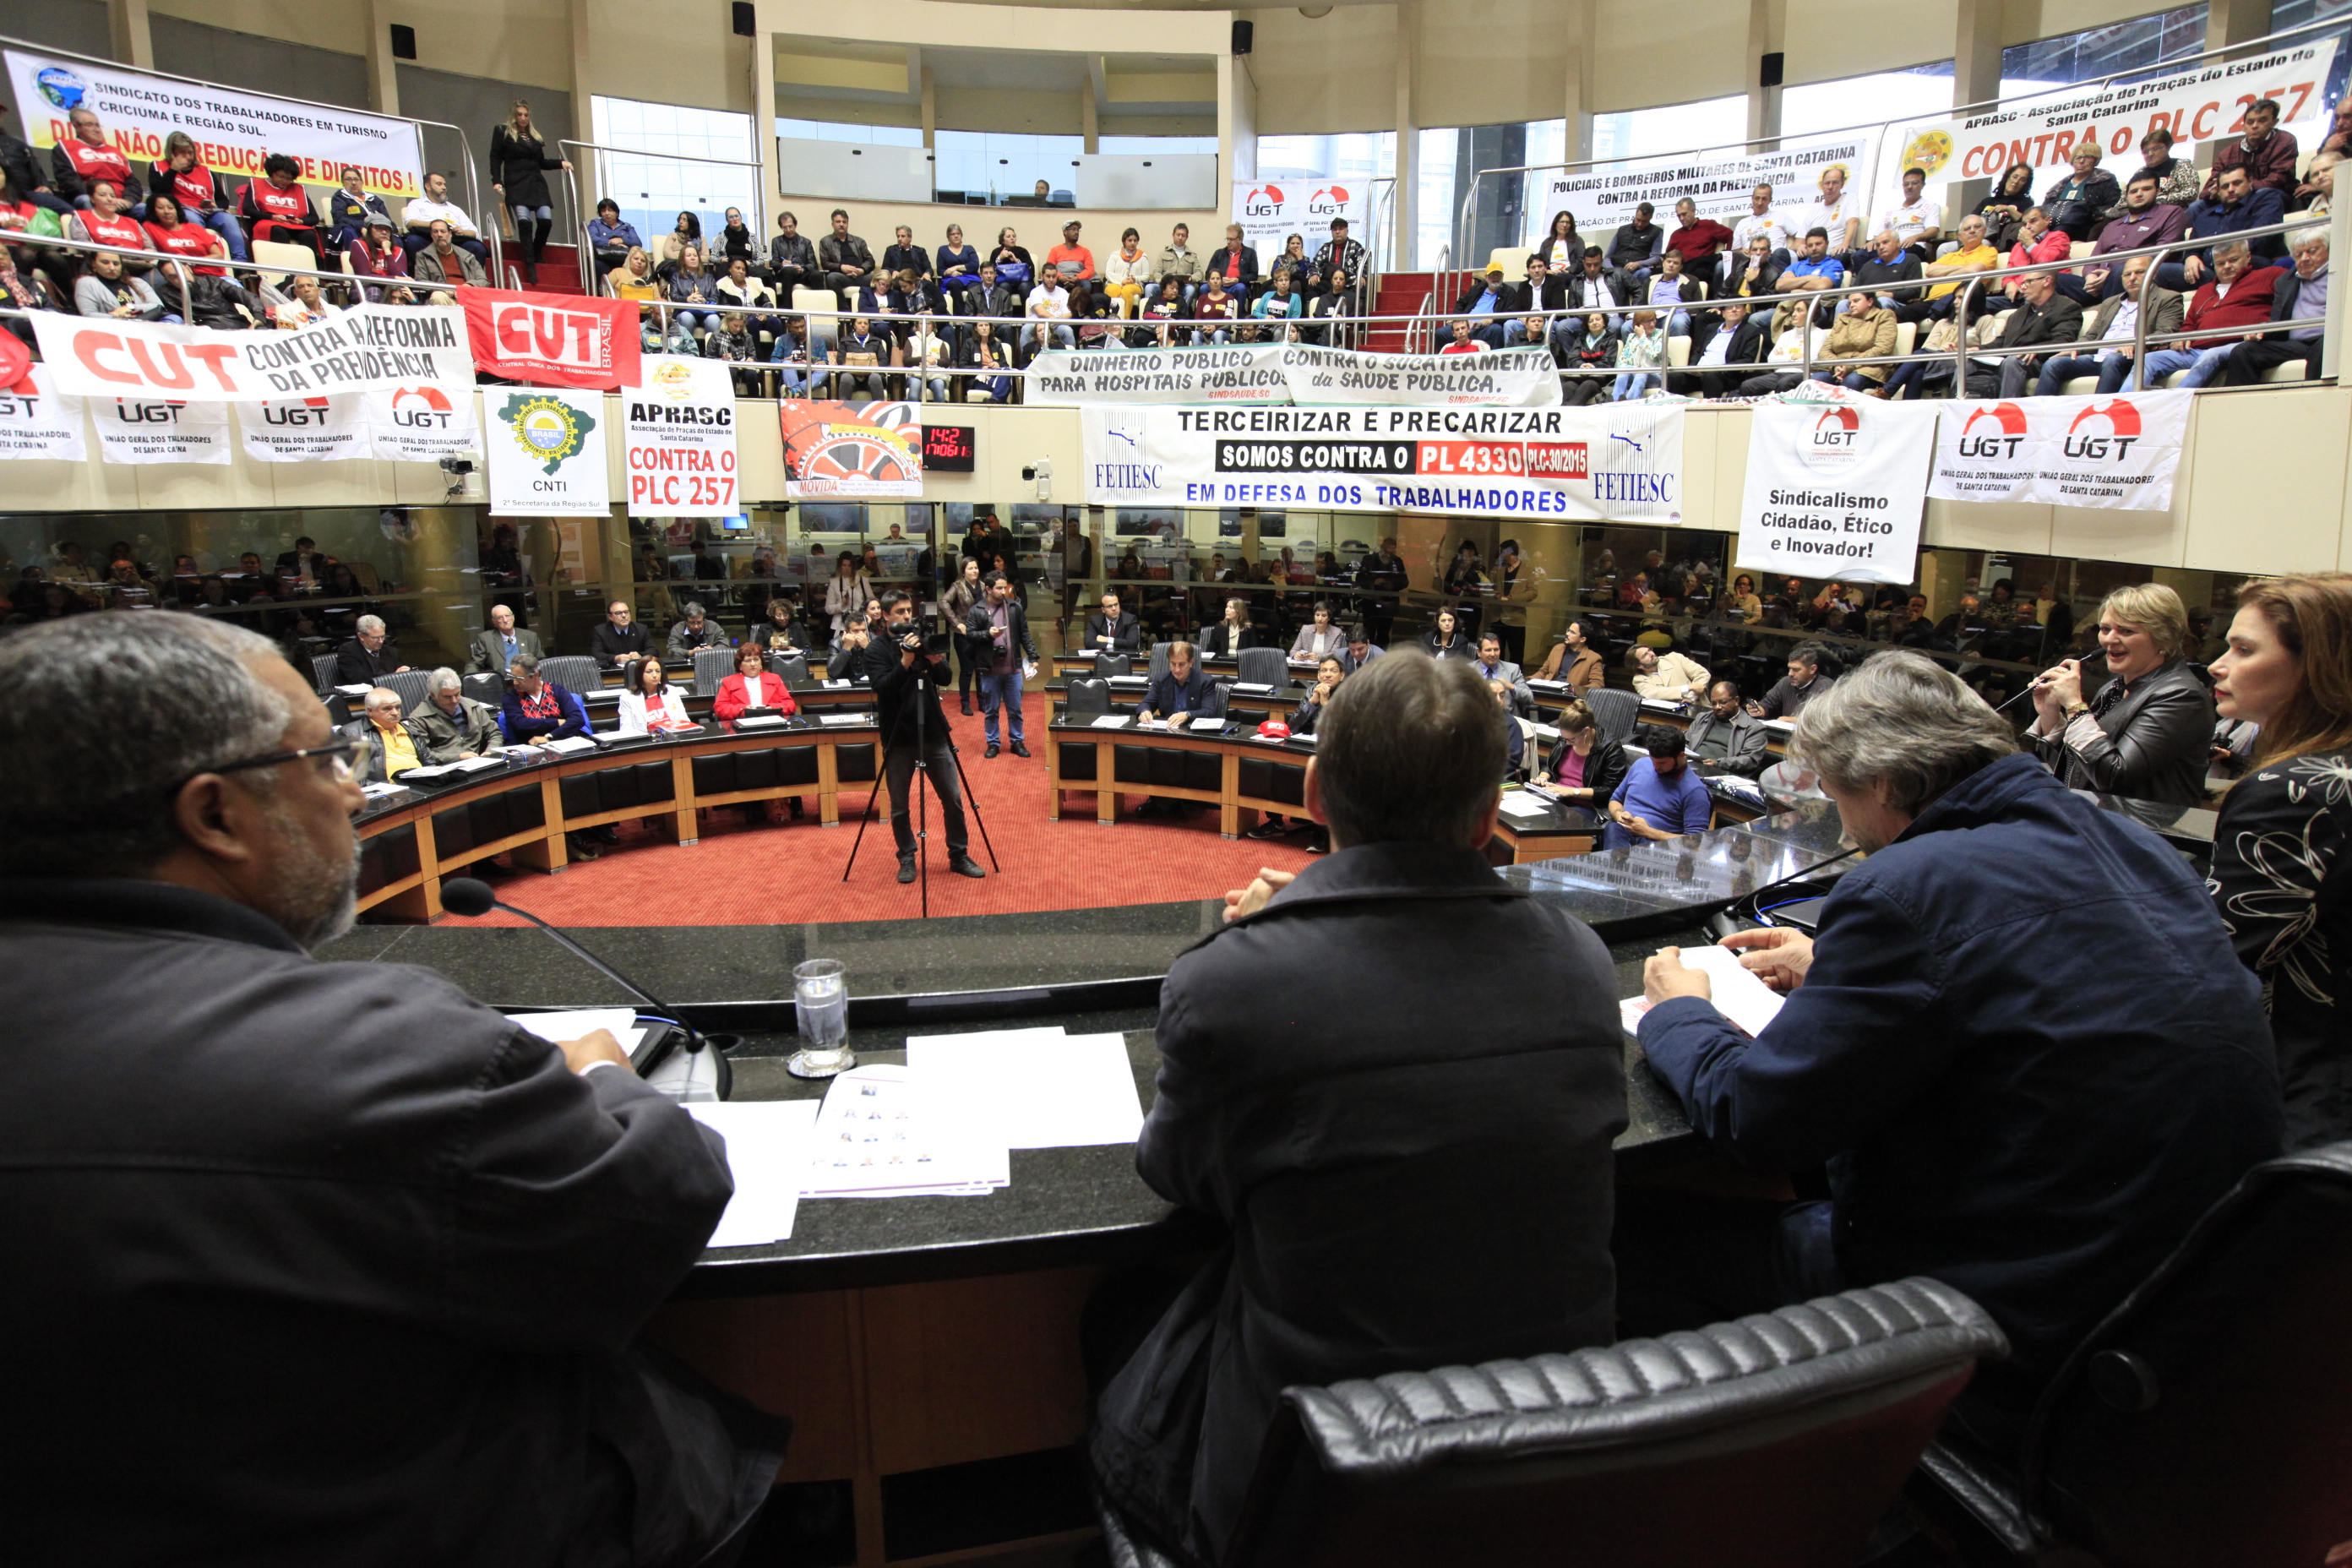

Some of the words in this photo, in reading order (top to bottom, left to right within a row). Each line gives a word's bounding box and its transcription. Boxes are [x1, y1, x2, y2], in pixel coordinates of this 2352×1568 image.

[1964, 112, 2017, 130] APRASC
[2028, 92, 2112, 118] Associação
[2117, 88, 2137, 100] de
[2140, 75, 2197, 96] Praças
[2201, 68, 2223, 83] do
[2226, 56, 2288, 78] Estado
[2291, 49, 2316, 62] de
[95, 82, 171, 105] SINDICATO
[174, 96, 202, 110] DOS
[205, 101, 313, 128] TRABALHADORES
[317, 120, 334, 132] EM
[336, 123, 388, 139] TURISMO
[100, 101, 169, 122] CRICIÚMA
[173, 113, 182, 123] E
[186, 115, 234, 132] REGIÃO
[238, 123, 267, 137] SUL.
[2046, 112, 2088, 128] Santa
[2091, 97, 2159, 119] Catarina
[78, 148, 119, 161] CUT
[115, 127, 162, 158] NÃO
[296, 155, 317, 179] DE
[1553, 178, 1603, 193] POLICIAIS
[1605, 177, 1611, 188] E
[1613, 171, 1674, 188] BOMBEIROS
[1676, 163, 1735, 181] MILITARES
[1738, 161, 1752, 172] DE
[1755, 155, 1793, 171] SANTA
[1795, 145, 1855, 166] CATARINA
[265, 194, 296, 206] CUT
[1597, 191, 1639, 206] CONTRA
[1641, 189, 1647, 202] A
[1650, 183, 1700, 201] REFORMA
[1703, 182, 1718, 195] DA
[1720, 172, 1795, 193] PREVIDÊNCIA
[1246, 204, 1285, 216] UGT
[1309, 203, 1349, 215] UGT
[1605, 216, 1617, 225] DE
[1656, 211, 1669, 220] DO
[1708, 206, 1720, 215] DE
[96, 226, 133, 239] CUT
[167, 238, 192, 248] CUT
[246, 326, 348, 371] CONTRA
[346, 317, 365, 346] A
[365, 314, 457, 348] REFORMA
[498, 306, 599, 362] CUT
[601, 314, 612, 368] BRASIL
[73, 329, 239, 392] CUT
[1070, 353, 1162, 373] DINHEIRO
[1173, 350, 1254, 370] PÚBLICO
[1282, 350, 1359, 370] CONTRA
[1365, 355, 1377, 370] O
[1382, 353, 1551, 372] SUCATEAMENTO
[268, 369, 311, 392] DA
[564, 367, 613, 377] TRABALHADORES
[1041, 376, 1086, 392] PARA
[1095, 373, 1193, 392] HOSPITAIS
[1312, 371, 1333, 388] da
[1340, 370, 1399, 390] SAÚDE
[1406, 371, 1502, 394] PÚBLICA.
[1208, 389, 1271, 399] SINDSAÚDE/SC
[118, 402, 187, 424] UGT
[264, 406, 329, 426] UGT
[392, 410, 453, 429] UGT
[630, 402, 732, 426] APRASC
[1178, 411, 1352, 433] TERCEIRIZAR
[1364, 406, 1378, 433] É
[1389, 411, 1562, 434] PRECARIZAR
[105, 433, 127, 443] UNIÃO
[272, 435, 292, 444] GERAL
[307, 434, 353, 444] TRABALHADORES
[631, 424, 667, 433] Associação
[1814, 431, 1857, 446] UGT
[1222, 444, 1294, 468] SOMOS
[1299, 444, 1387, 469] CONTRA
[1394, 446, 1408, 468] O
[1421, 446, 1454, 472] PL
[1459, 446, 1523, 473] 4330
[1527, 448, 1587, 473] PLC-30/2015
[1958, 435, 2025, 460] UGT
[2063, 434, 2138, 462] UGT
[629, 446, 715, 471] CONTRA
[721, 449, 735, 472] O
[1095, 464, 1163, 489] FETIESC
[1940, 468, 1955, 478] UNIÃO
[1955, 471, 1974, 479] GERAL
[1975, 471, 1987, 480] DOS
[2039, 470, 2058, 480] UNIÃO
[2060, 473, 2078, 482] GERAL
[2080, 475, 2093, 483] DOS
[2093, 475, 2154, 485] TRABALHADORES
[532, 480, 567, 492] CNTI
[632, 475, 680, 505] PLC
[689, 476, 735, 506] 257
[799, 480, 837, 493] MOVIDA
[1593, 472, 1674, 503] FETIESC
[1984, 483, 2012, 492] CATARINA
[2060, 485, 2068, 493] DE
[2069, 486, 2088, 495] SANTA
[2088, 487, 2123, 497] CATARINA
[563, 500, 586, 509] Região
[1186, 483, 1216, 502] EM
[1225, 484, 1307, 504] DEFESA
[1318, 485, 1363, 505] DOS
[1375, 487, 1566, 513] TRABALHADORES
[1769, 489, 1889, 509] Sindicalismo
[1761, 512, 1838, 535] Cidadão,
[1843, 512, 1893, 535] Ético
[1771, 539, 1781, 551] e
[1786, 537, 1874, 558] Inovador!
